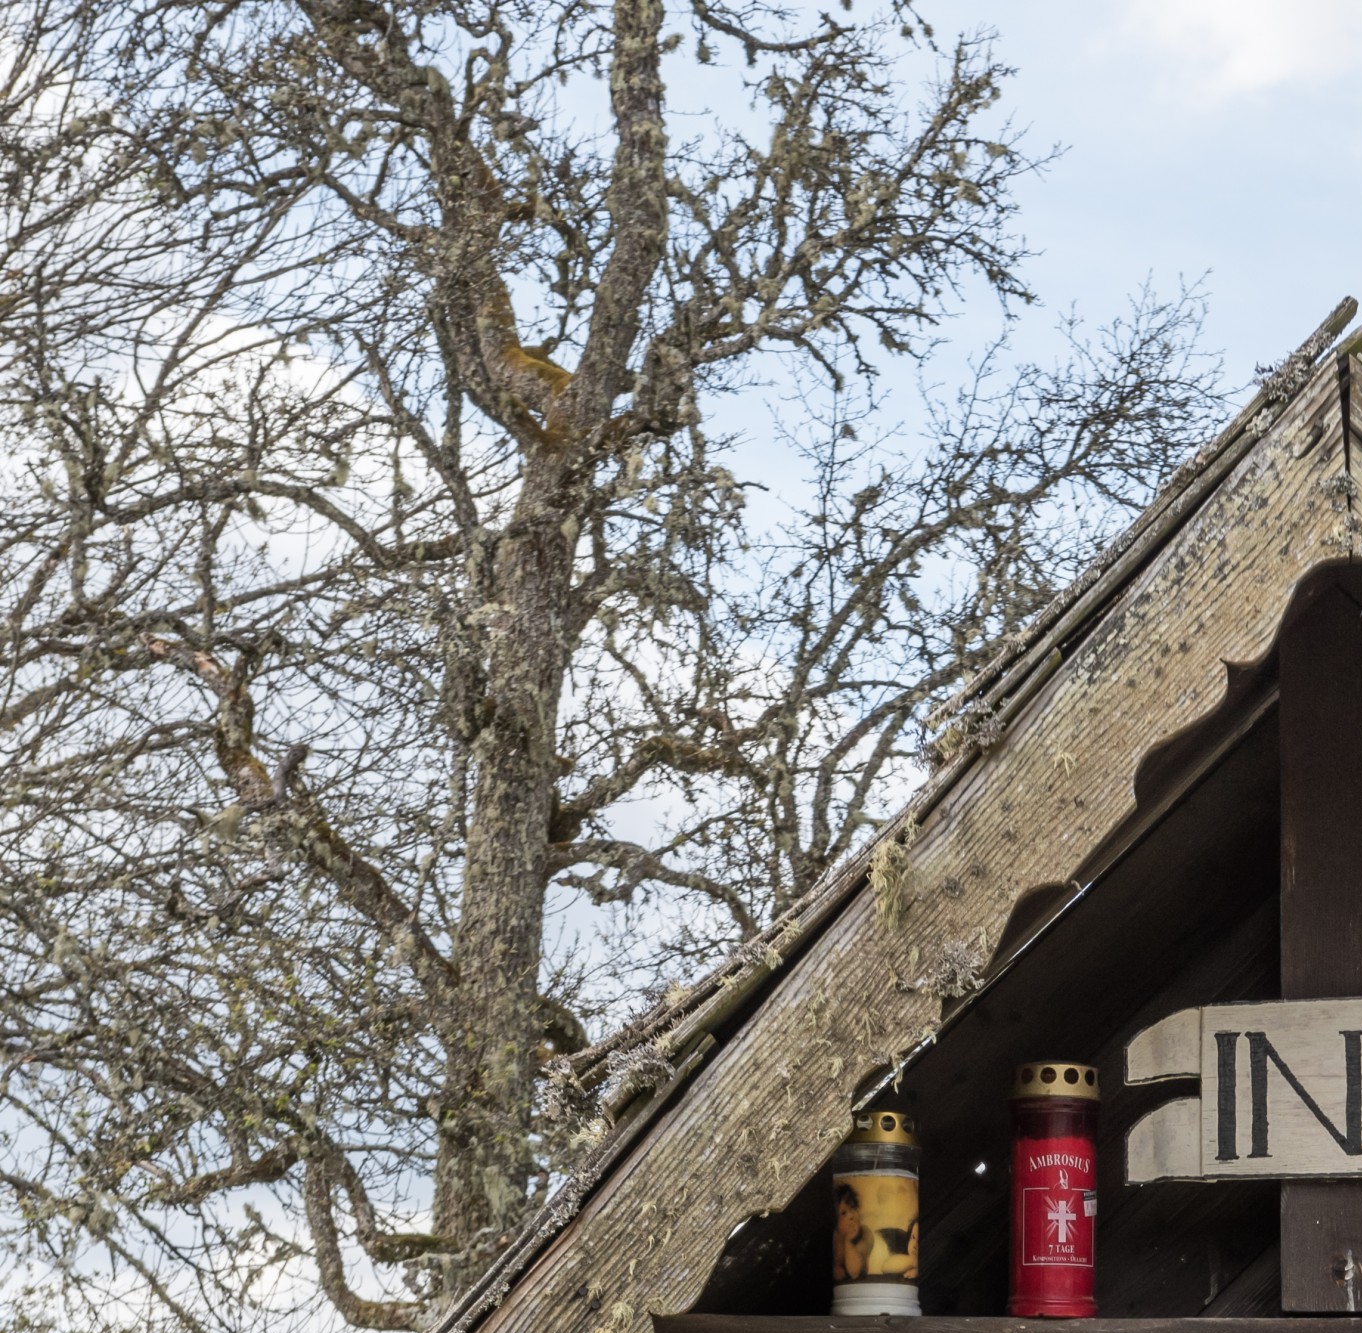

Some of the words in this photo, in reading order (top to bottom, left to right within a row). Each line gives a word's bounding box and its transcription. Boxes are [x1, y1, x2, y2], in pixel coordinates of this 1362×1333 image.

[1029, 1154, 1091, 1174] AMBROSIUS
[1048, 1244, 1053, 1255] 7
[1055, 1244, 1075, 1254] TAGE
